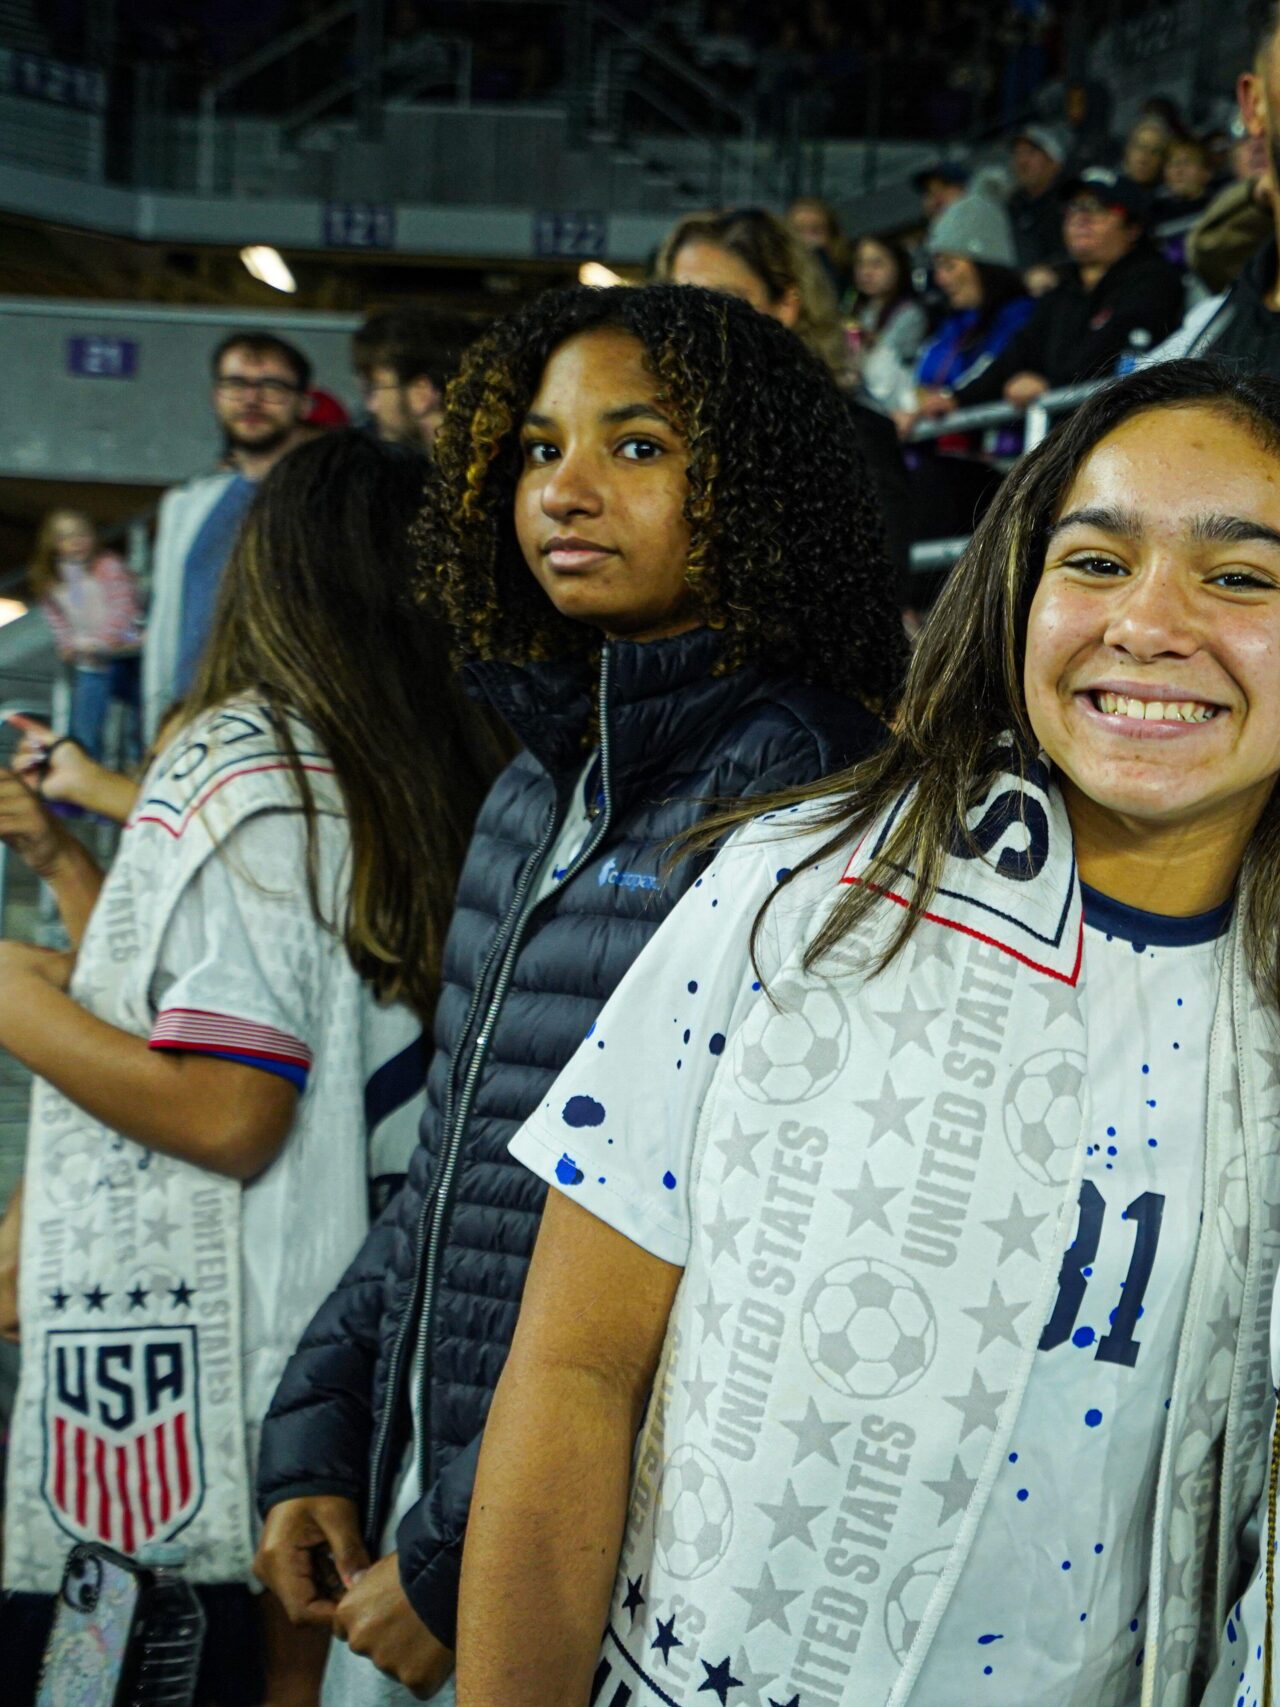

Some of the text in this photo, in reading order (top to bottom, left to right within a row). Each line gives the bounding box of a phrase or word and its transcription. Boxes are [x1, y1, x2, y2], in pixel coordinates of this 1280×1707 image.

[900, 939, 1020, 1268] UNITED STATE
[56, 1342, 184, 1431] USA
[192, 1187, 233, 1405] UNITED STATES
[711, 1120, 829, 1462] UNITED STATES
[824, 1414, 916, 1584] STATES
